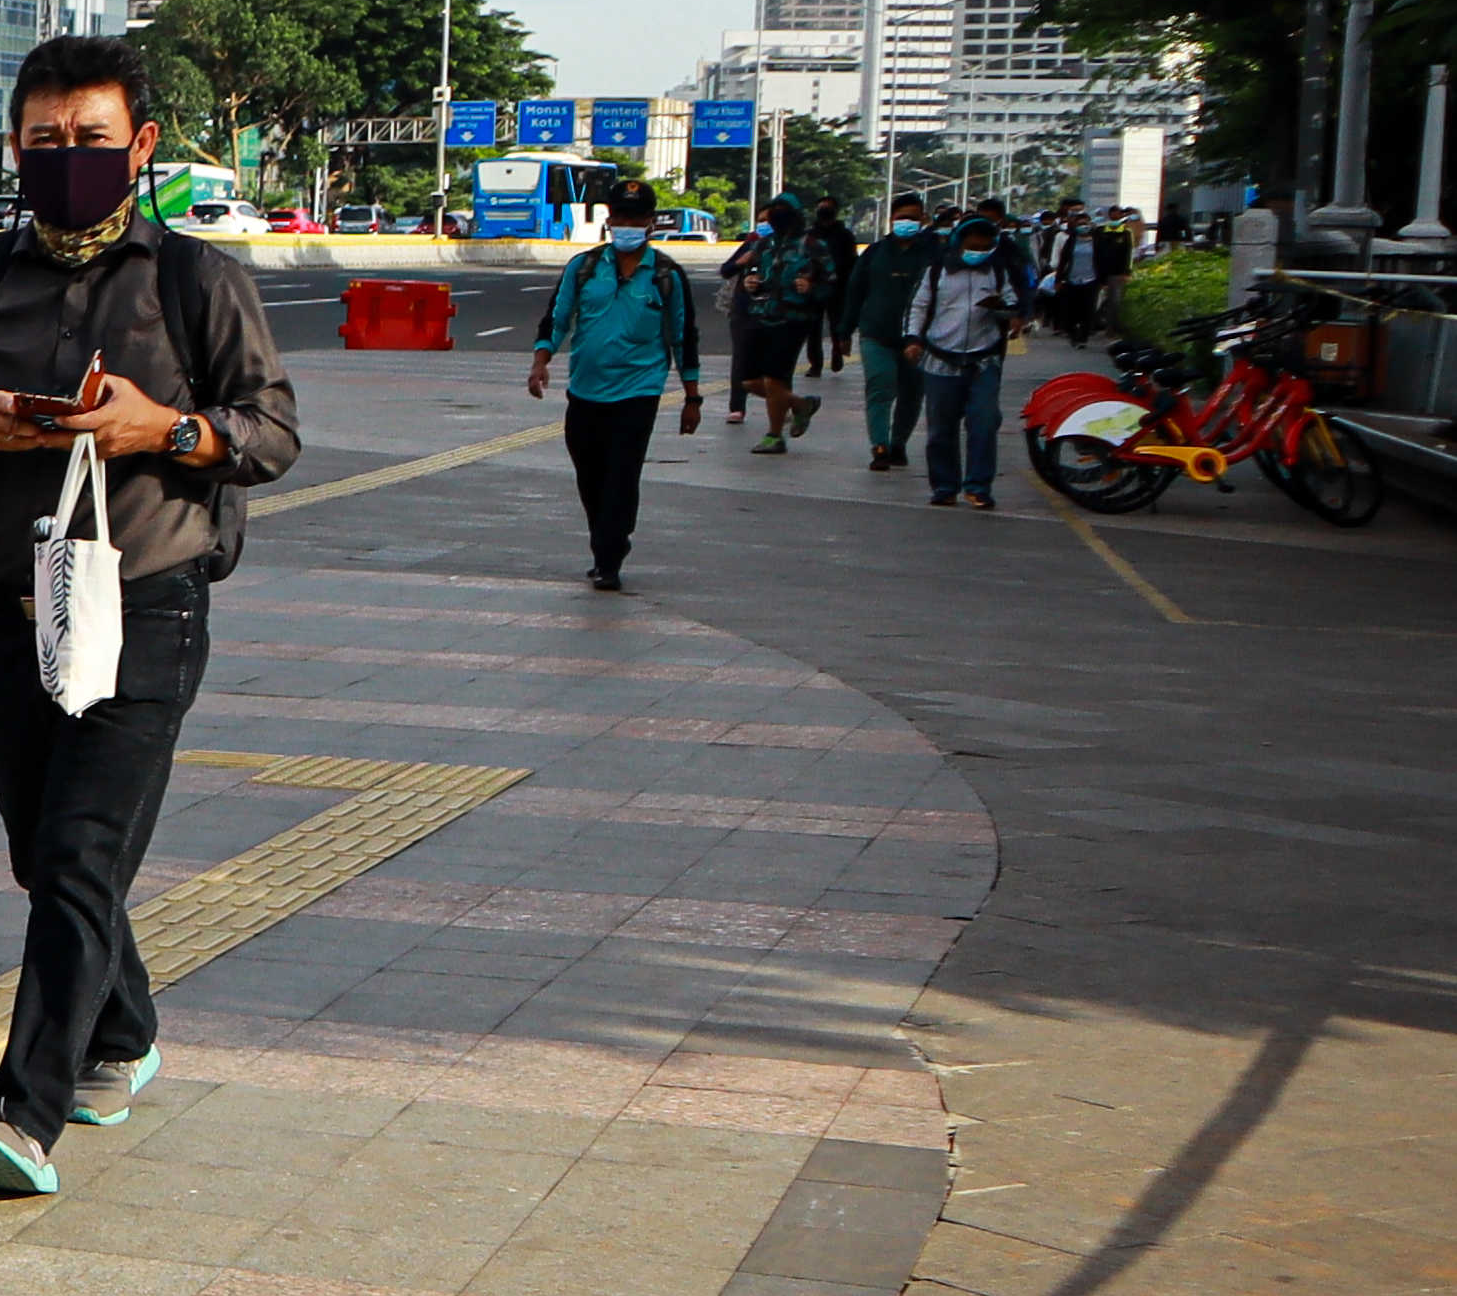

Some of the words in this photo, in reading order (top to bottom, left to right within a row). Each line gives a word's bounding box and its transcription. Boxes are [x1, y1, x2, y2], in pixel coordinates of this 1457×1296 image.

[525, 106, 568, 115] Monas
[594, 106, 647, 117] Menteng
[531, 118, 561, 128] Kota
[602, 119, 637, 129] Cikini
